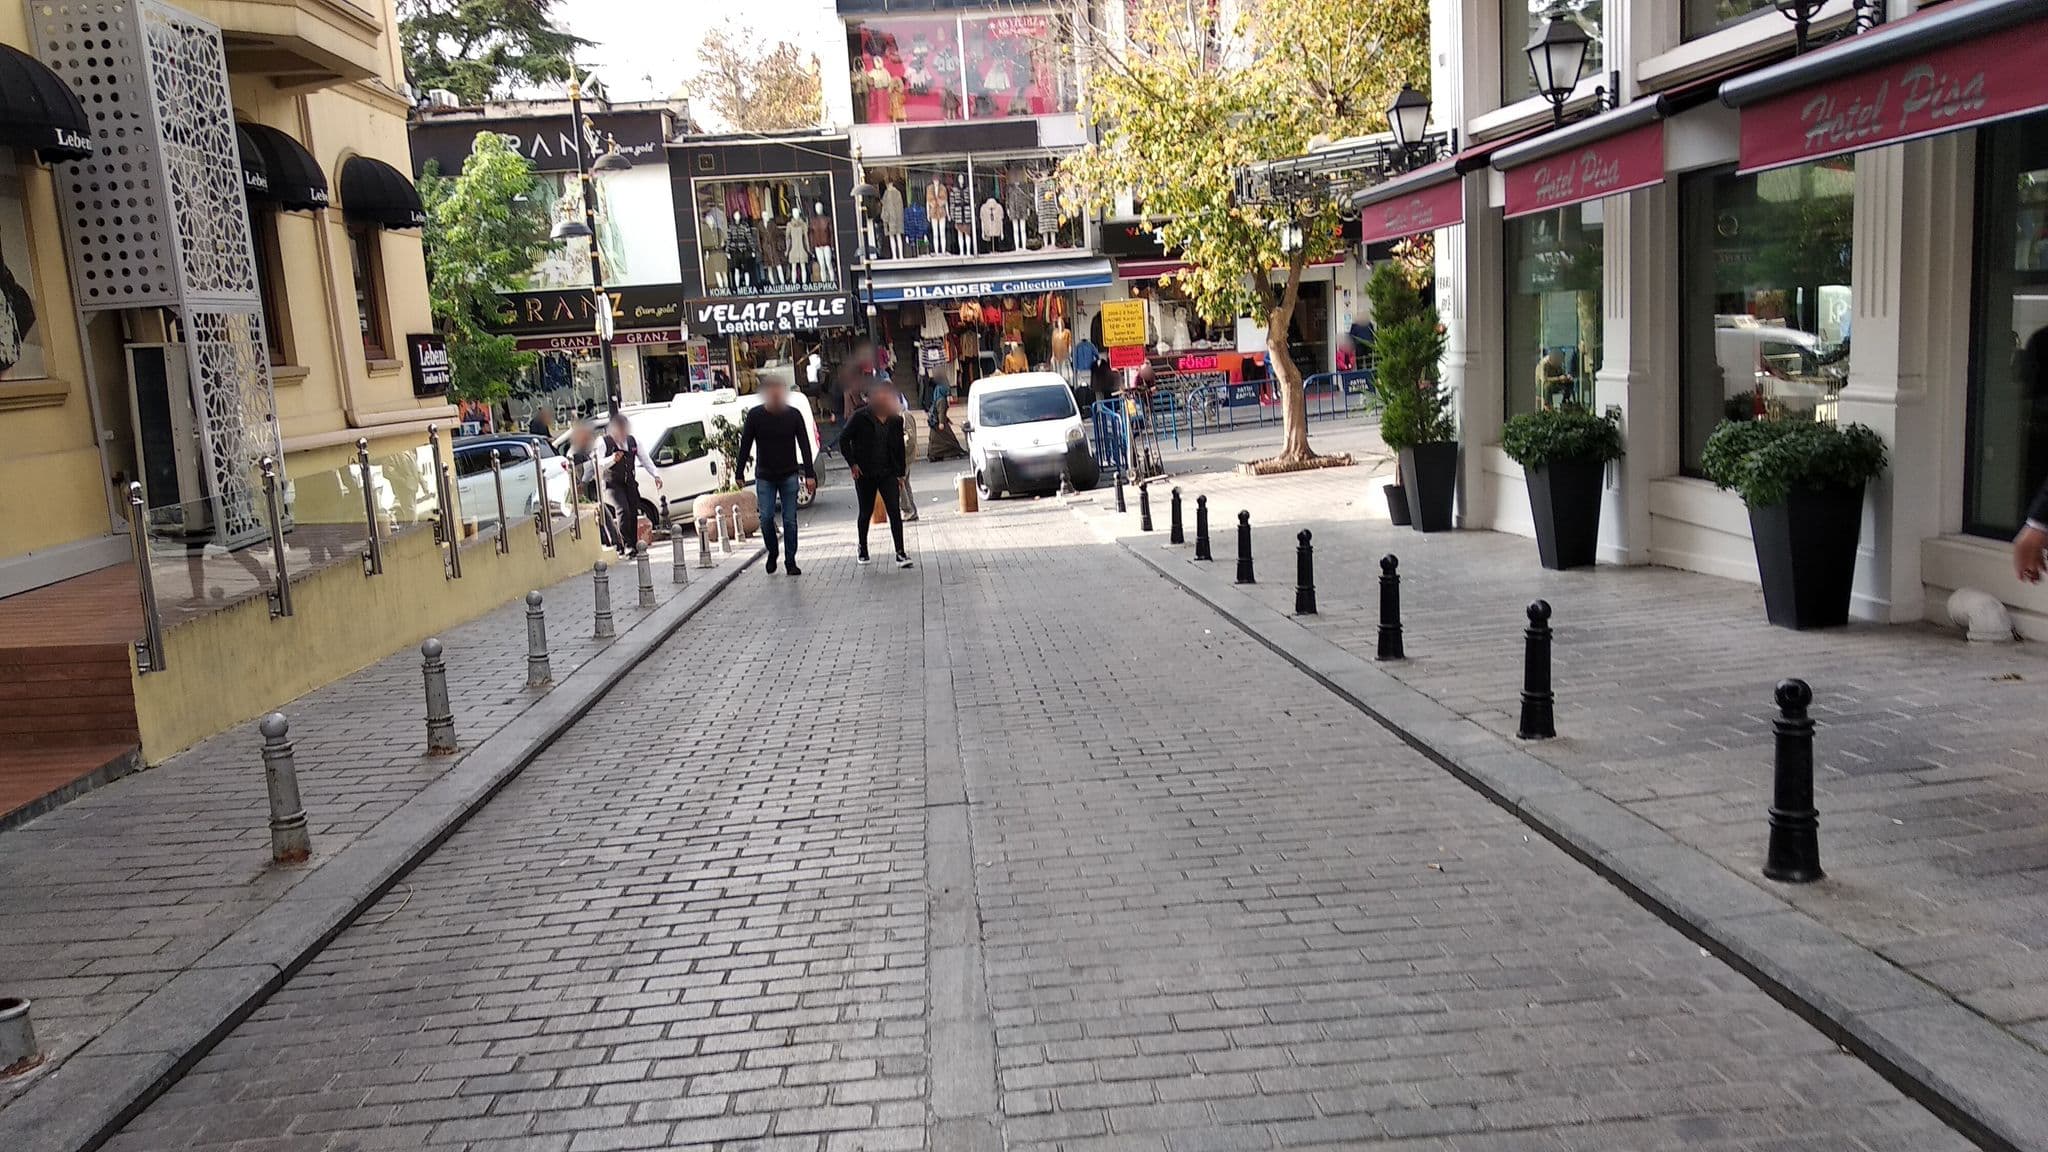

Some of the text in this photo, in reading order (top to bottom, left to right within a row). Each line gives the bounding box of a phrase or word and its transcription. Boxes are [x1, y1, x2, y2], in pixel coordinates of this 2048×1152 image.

[1801, 64, 1988, 150] Hotel Pisa
[1534, 150, 1620, 203] Hotel Pisa
[709, 282, 838, 297] КОЖА МЕХА КАШЕМИР ФАБРИКА
[1002, 279, 1066, 292] Collection
[698, 297, 847, 323] VELAT PELLE
[717, 315, 820, 334] Leather & Fur
[551, 331, 670, 348] GRANZ GRANZ
[418, 343, 449, 366] Lebeni
